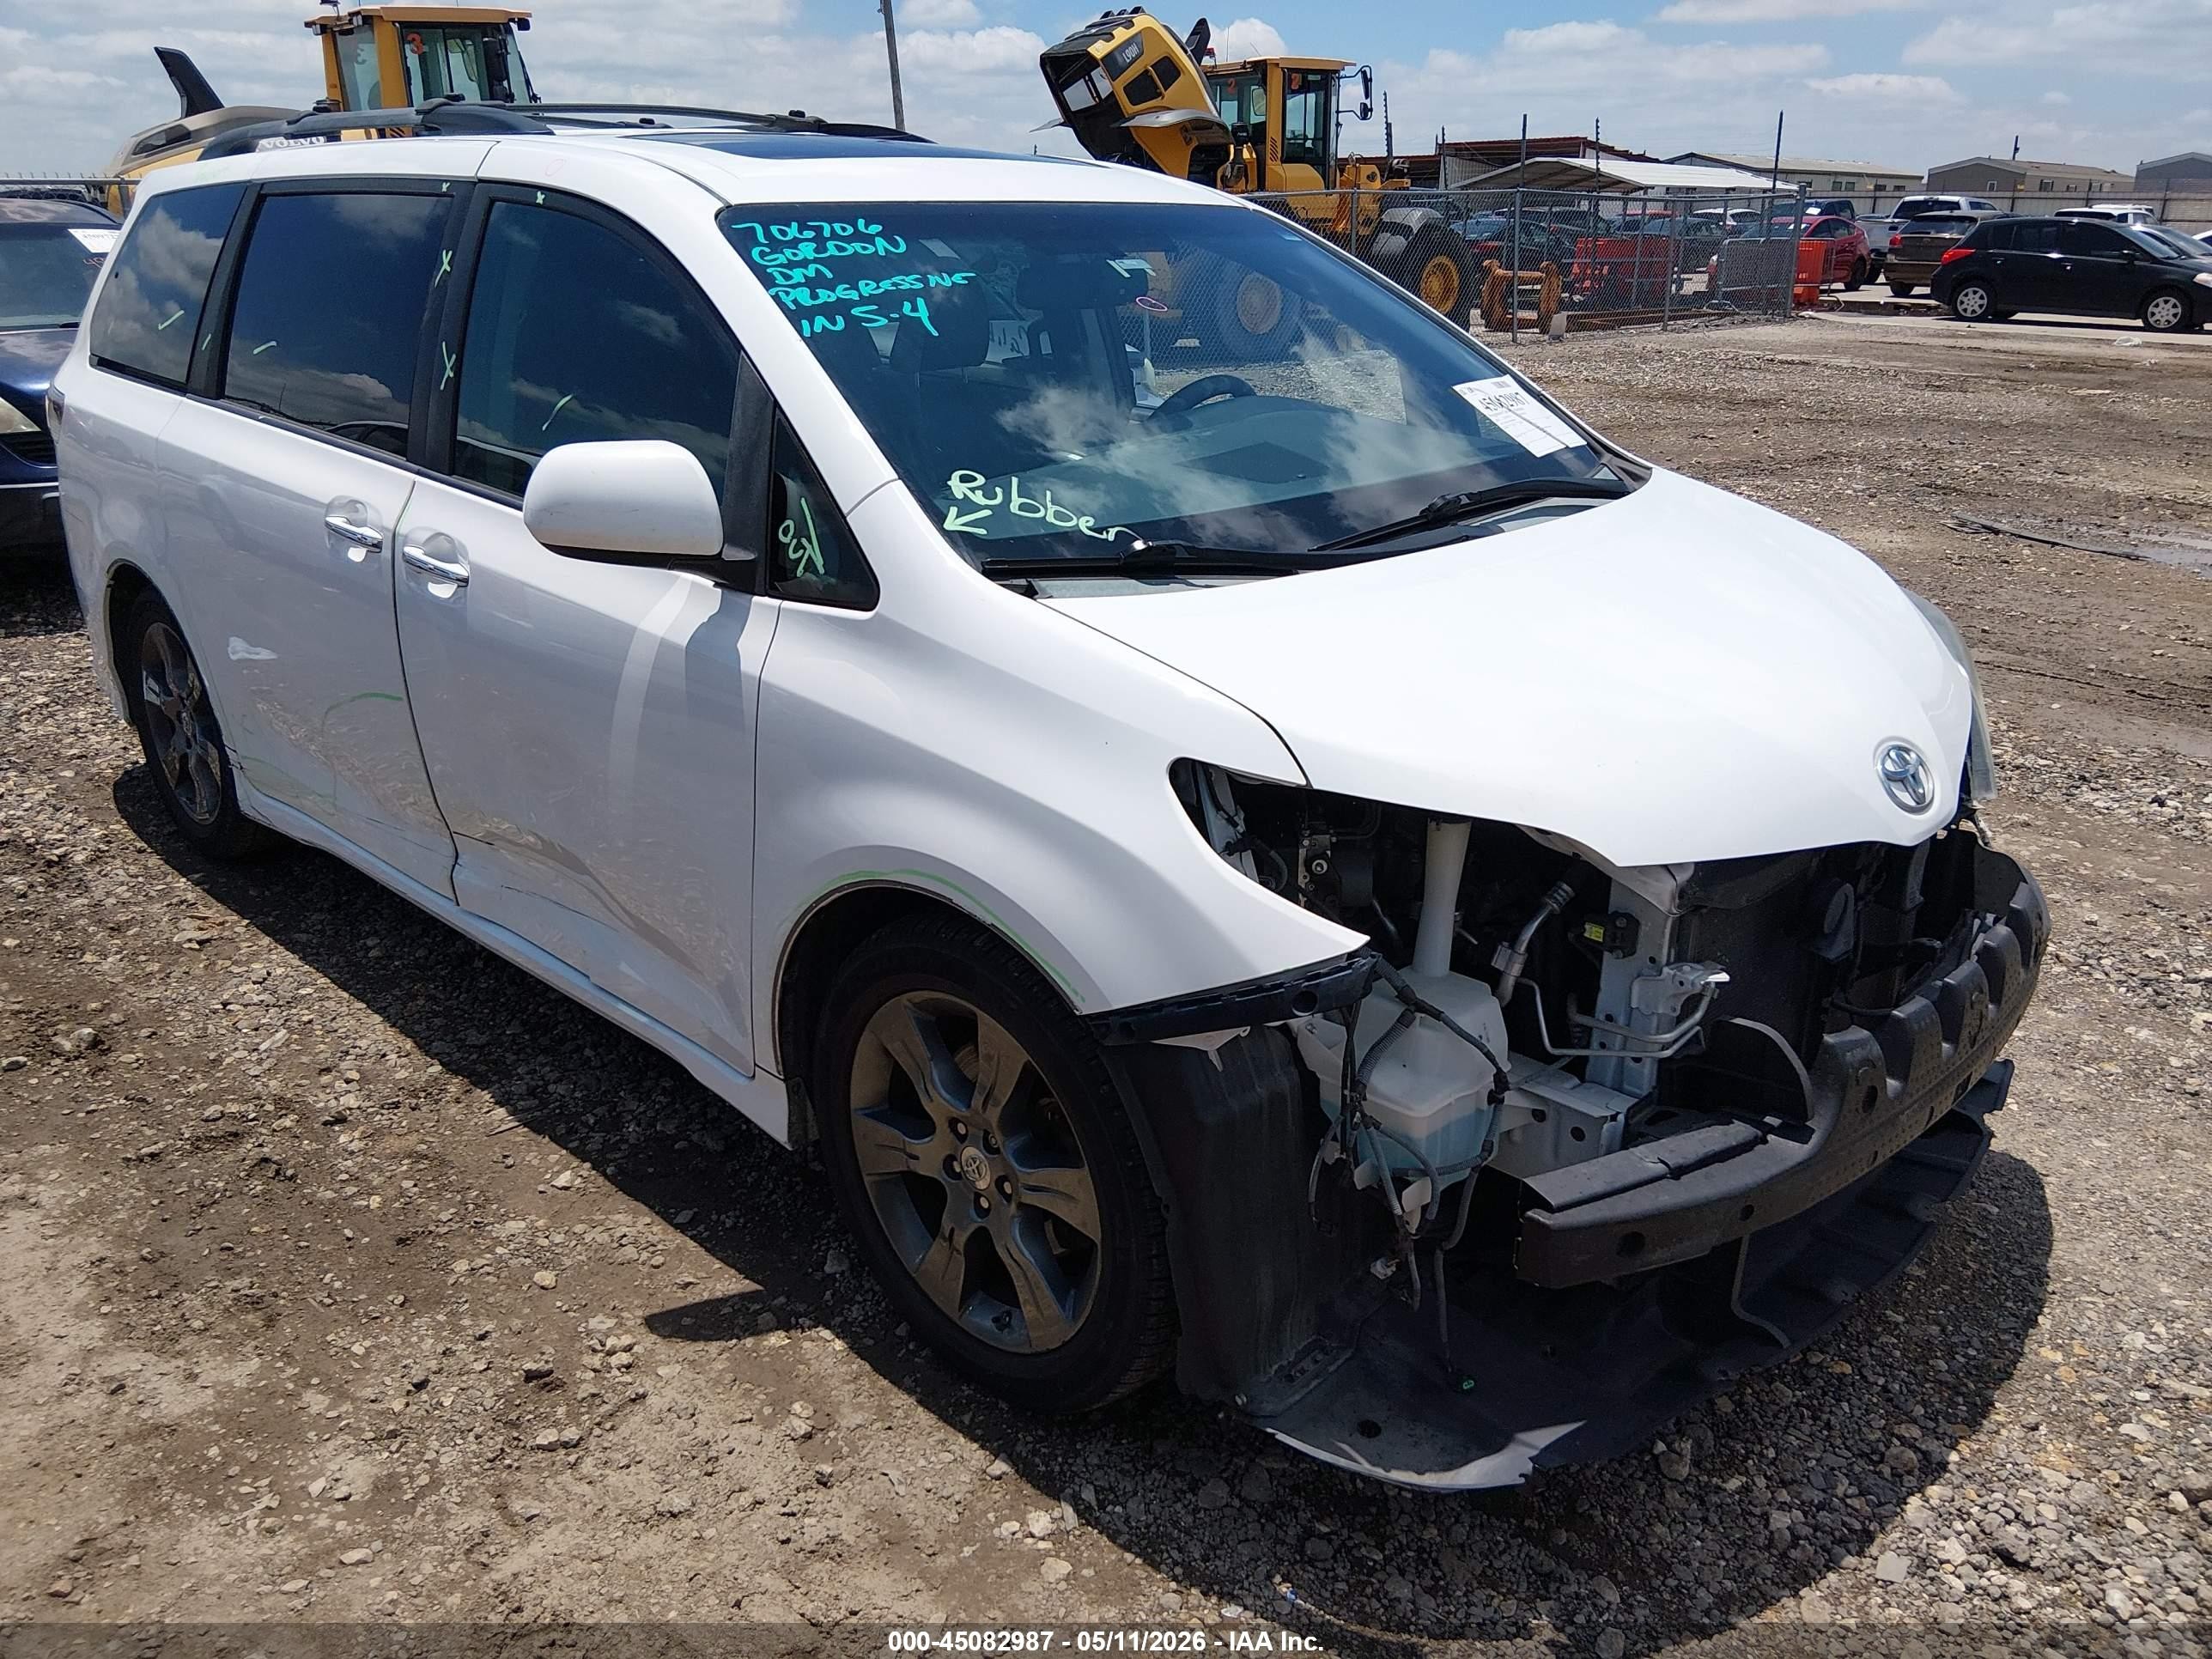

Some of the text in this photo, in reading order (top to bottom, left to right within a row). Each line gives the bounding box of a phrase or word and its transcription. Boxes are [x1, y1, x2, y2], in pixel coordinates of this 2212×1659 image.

[259, 136, 325, 149] VOLVO
[731, 218, 883, 244] 706706
[751, 235, 907, 265] GORDON
[767, 264, 833, 285] DM
[800, 315, 844, 337] IN
